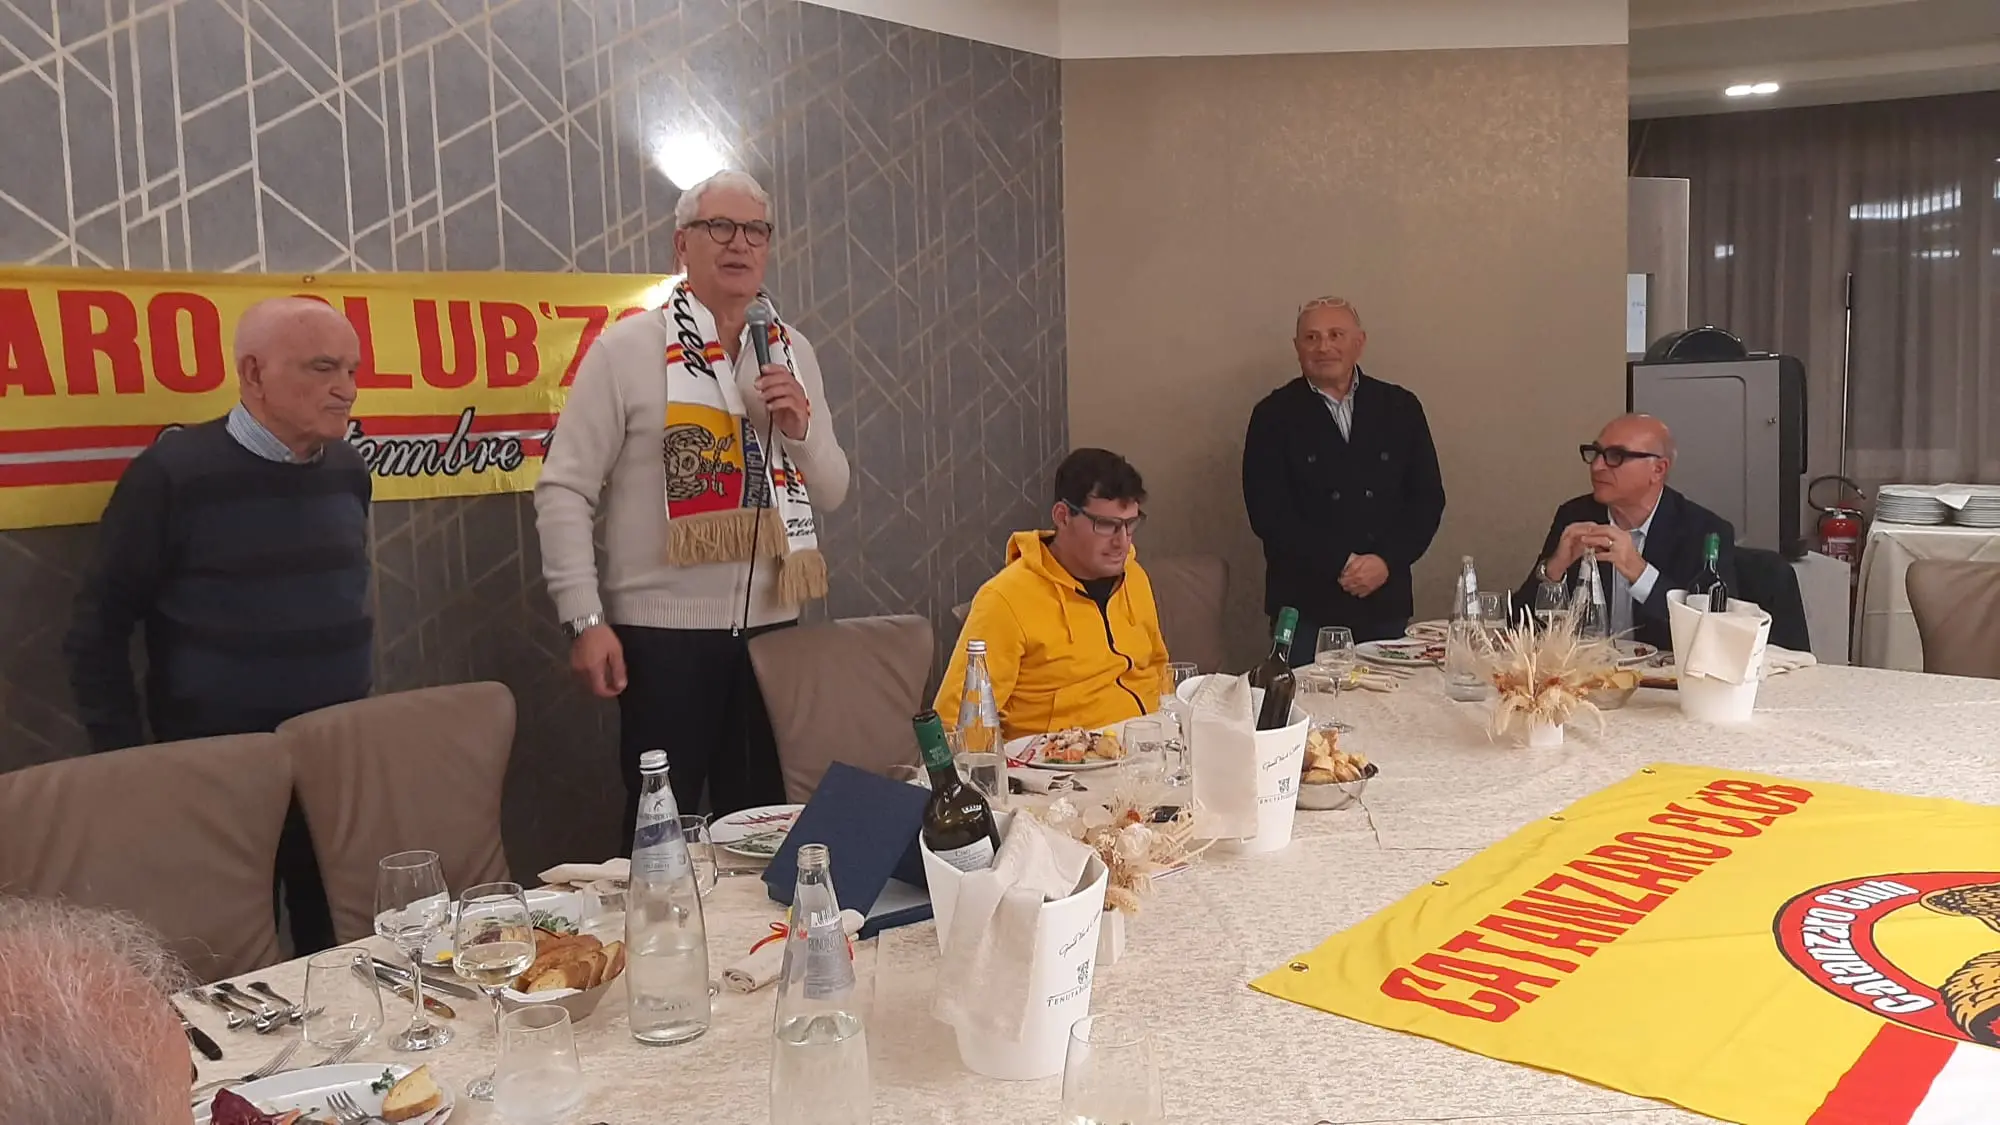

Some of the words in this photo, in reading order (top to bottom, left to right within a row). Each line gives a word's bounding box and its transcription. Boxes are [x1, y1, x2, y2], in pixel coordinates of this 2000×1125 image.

[341, 406, 524, 477] tembre
[1380, 832, 1733, 1023] CATANZARO
[1648, 779, 1814, 838] CLUB
[1814, 880, 1920, 910] Club
[1801, 907, 1937, 1014] Catanzaro
